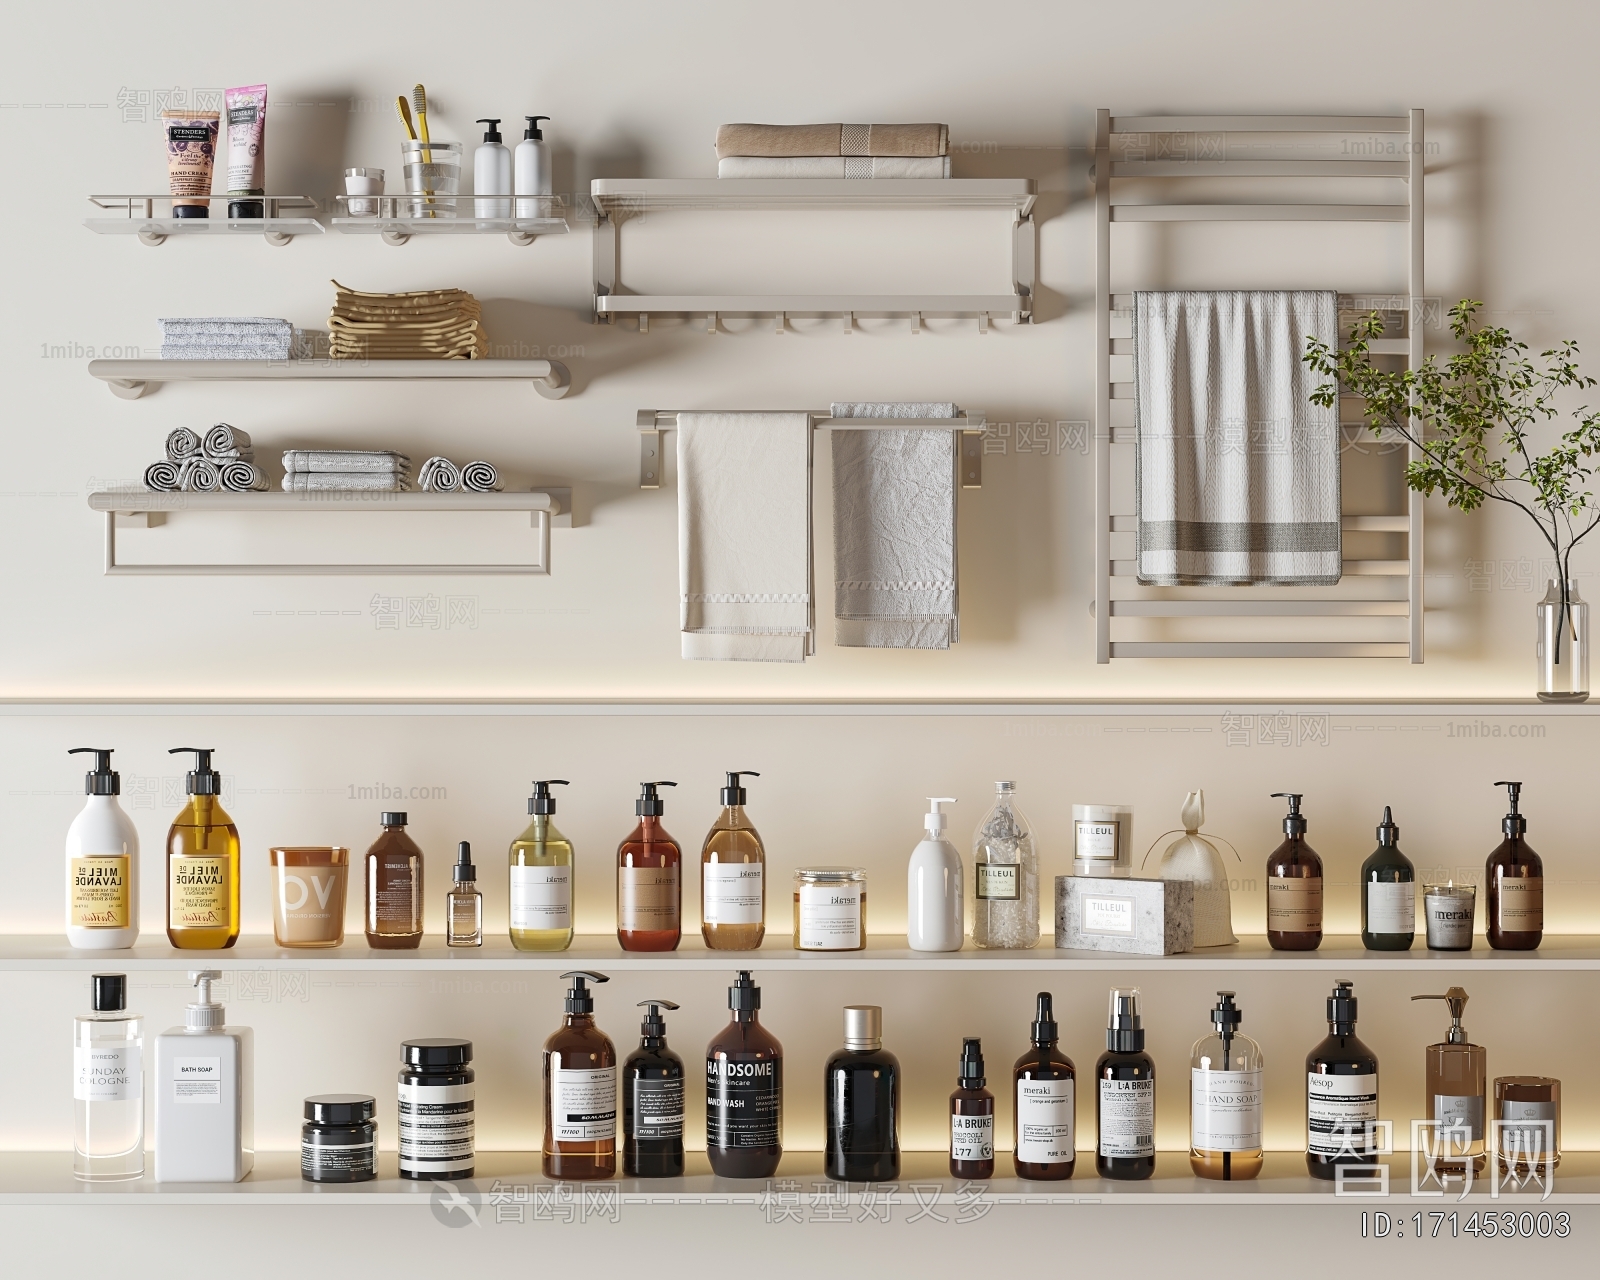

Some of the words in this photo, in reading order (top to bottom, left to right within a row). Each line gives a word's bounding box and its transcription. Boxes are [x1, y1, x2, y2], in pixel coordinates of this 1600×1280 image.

[1092, 903, 1126, 912] TILLEUL
[1435, 909, 1472, 920] meraki
[708, 1061, 772, 1077] HANDSOME
[80, 1077, 130, 1085] COLOGNE
[1310, 1076, 1333, 1090] Aesop
[708, 1097, 720, 1106] HAND
[1205, 1095, 1233, 1103] HAND
[1236, 1095, 1257, 1103] SOAP
[955, 1148, 972, 1156] 177
